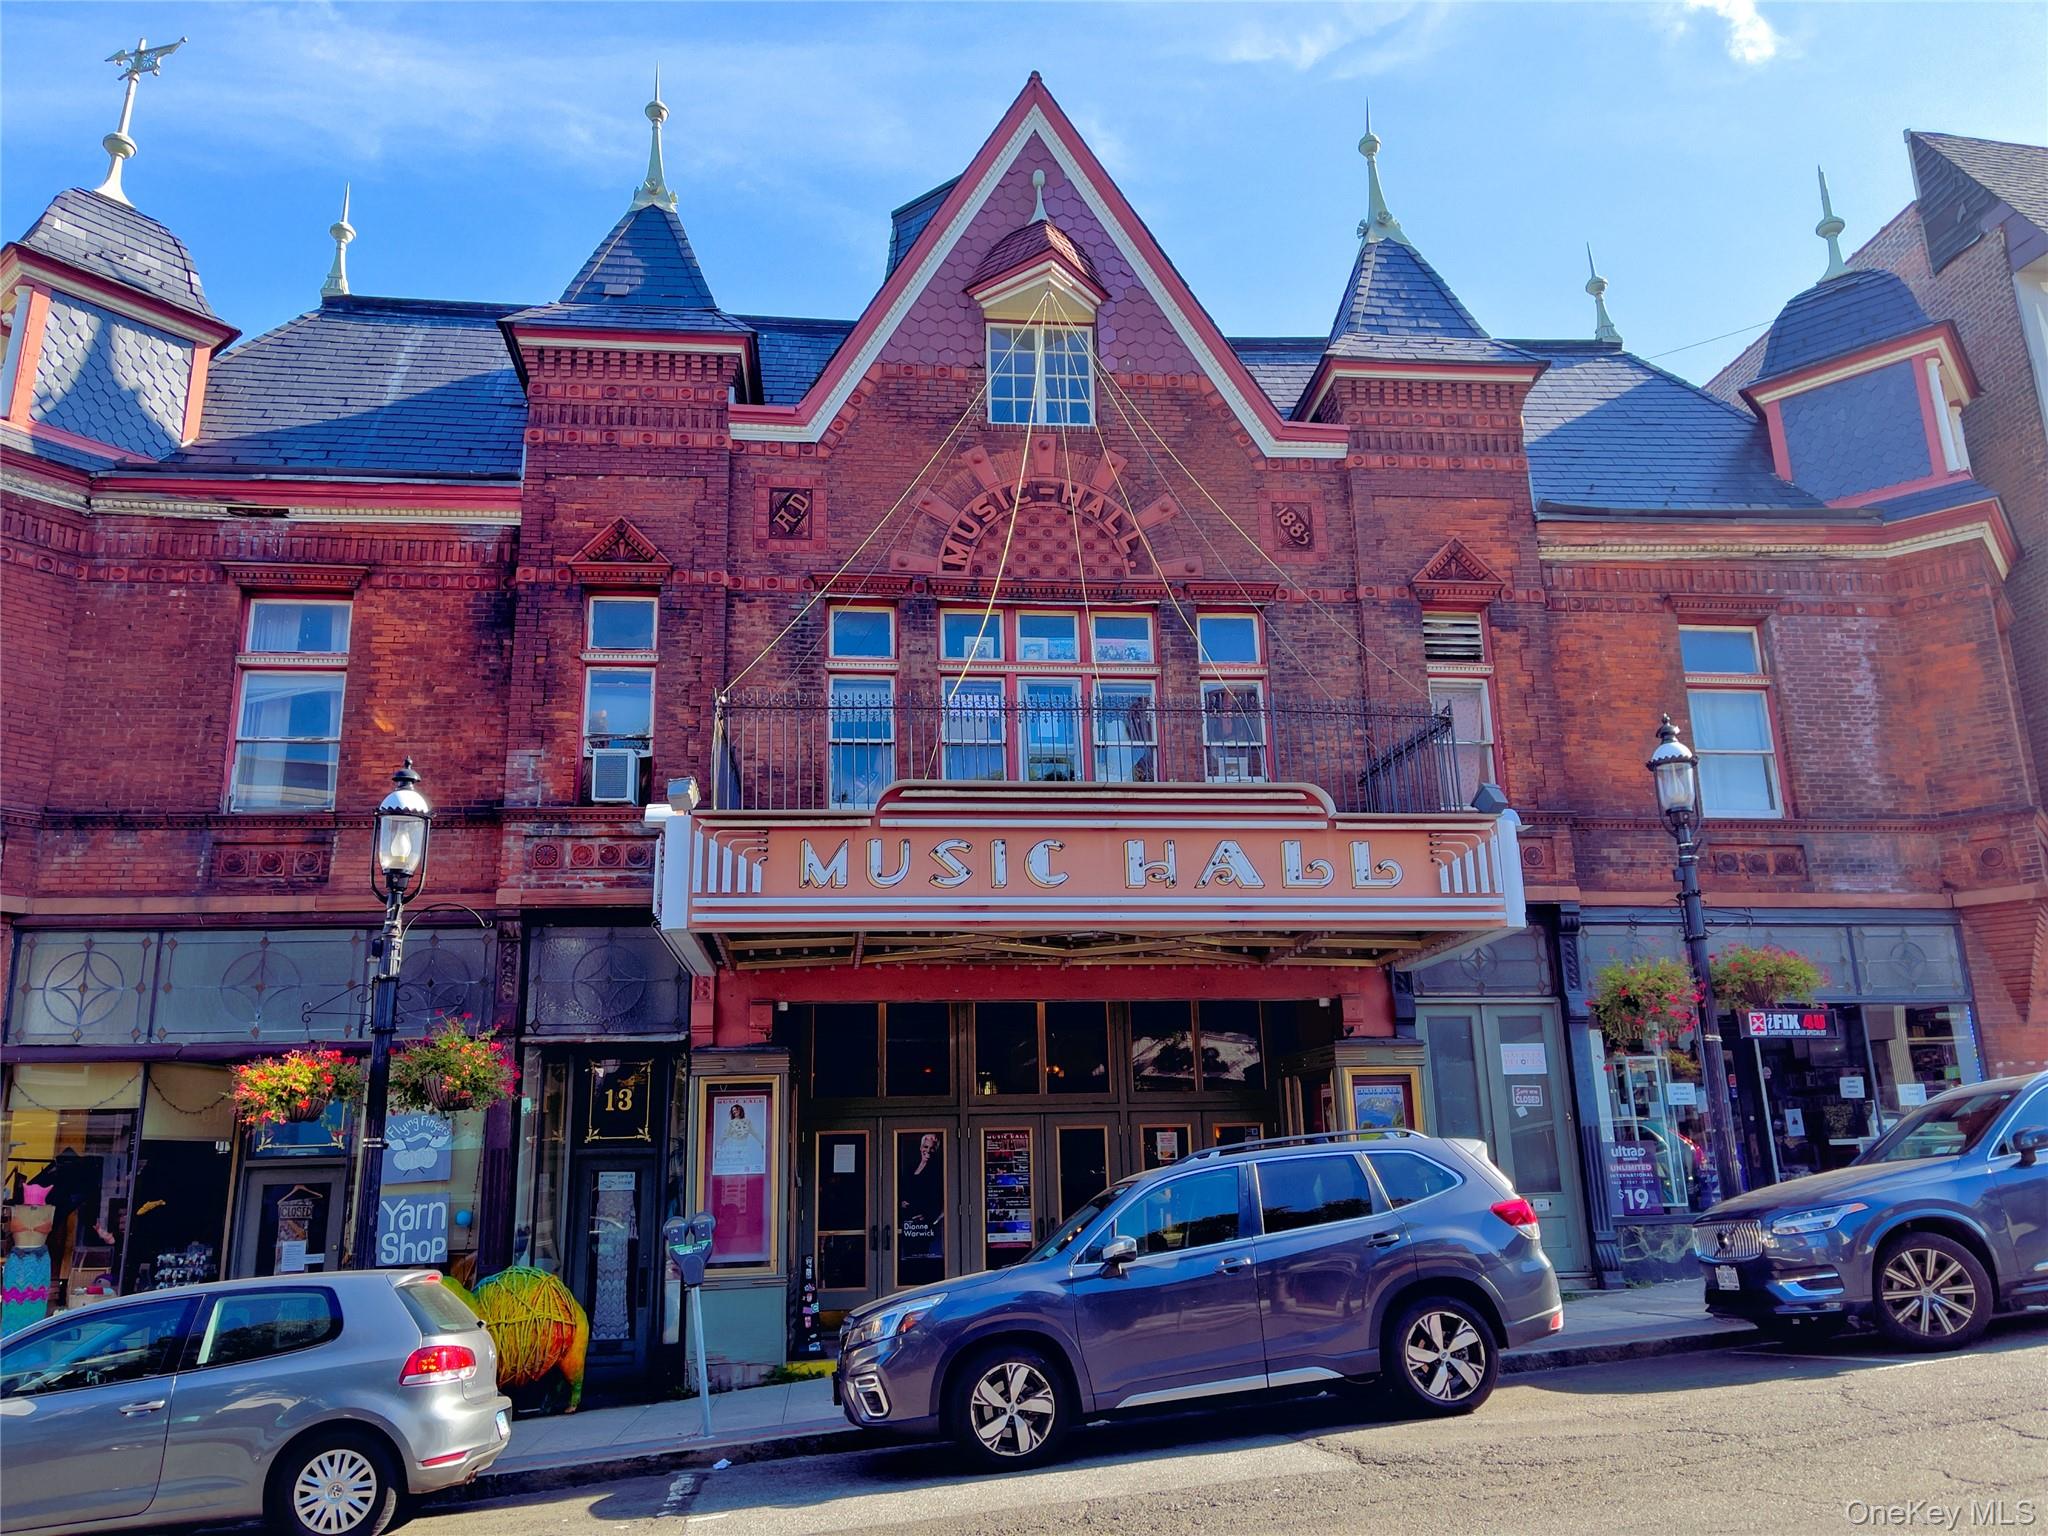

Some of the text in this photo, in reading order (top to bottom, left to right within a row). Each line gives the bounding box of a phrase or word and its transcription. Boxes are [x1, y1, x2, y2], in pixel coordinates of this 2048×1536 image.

[1276, 506, 1310, 546] 1885
[799, 838, 1404, 889] MUSIC HALL
[1767, 1014, 1826, 1030] iFIX 4U
[605, 1088, 633, 1111] 13
[1516, 1096, 1540, 1104] CLOSED
[386, 1115, 451, 1138] Flying Fingers
[1610, 1164, 1652, 1172] UNLIMITED
[1618, 1188, 1649, 1210] $19
[281, 1206, 312, 1217] CLOSED
[381, 1198, 447, 1232] Yarn
[903, 1222, 929, 1230] Dionne
[903, 1229, 934, 1238] Warwick
[380, 1232, 447, 1264] Shop
